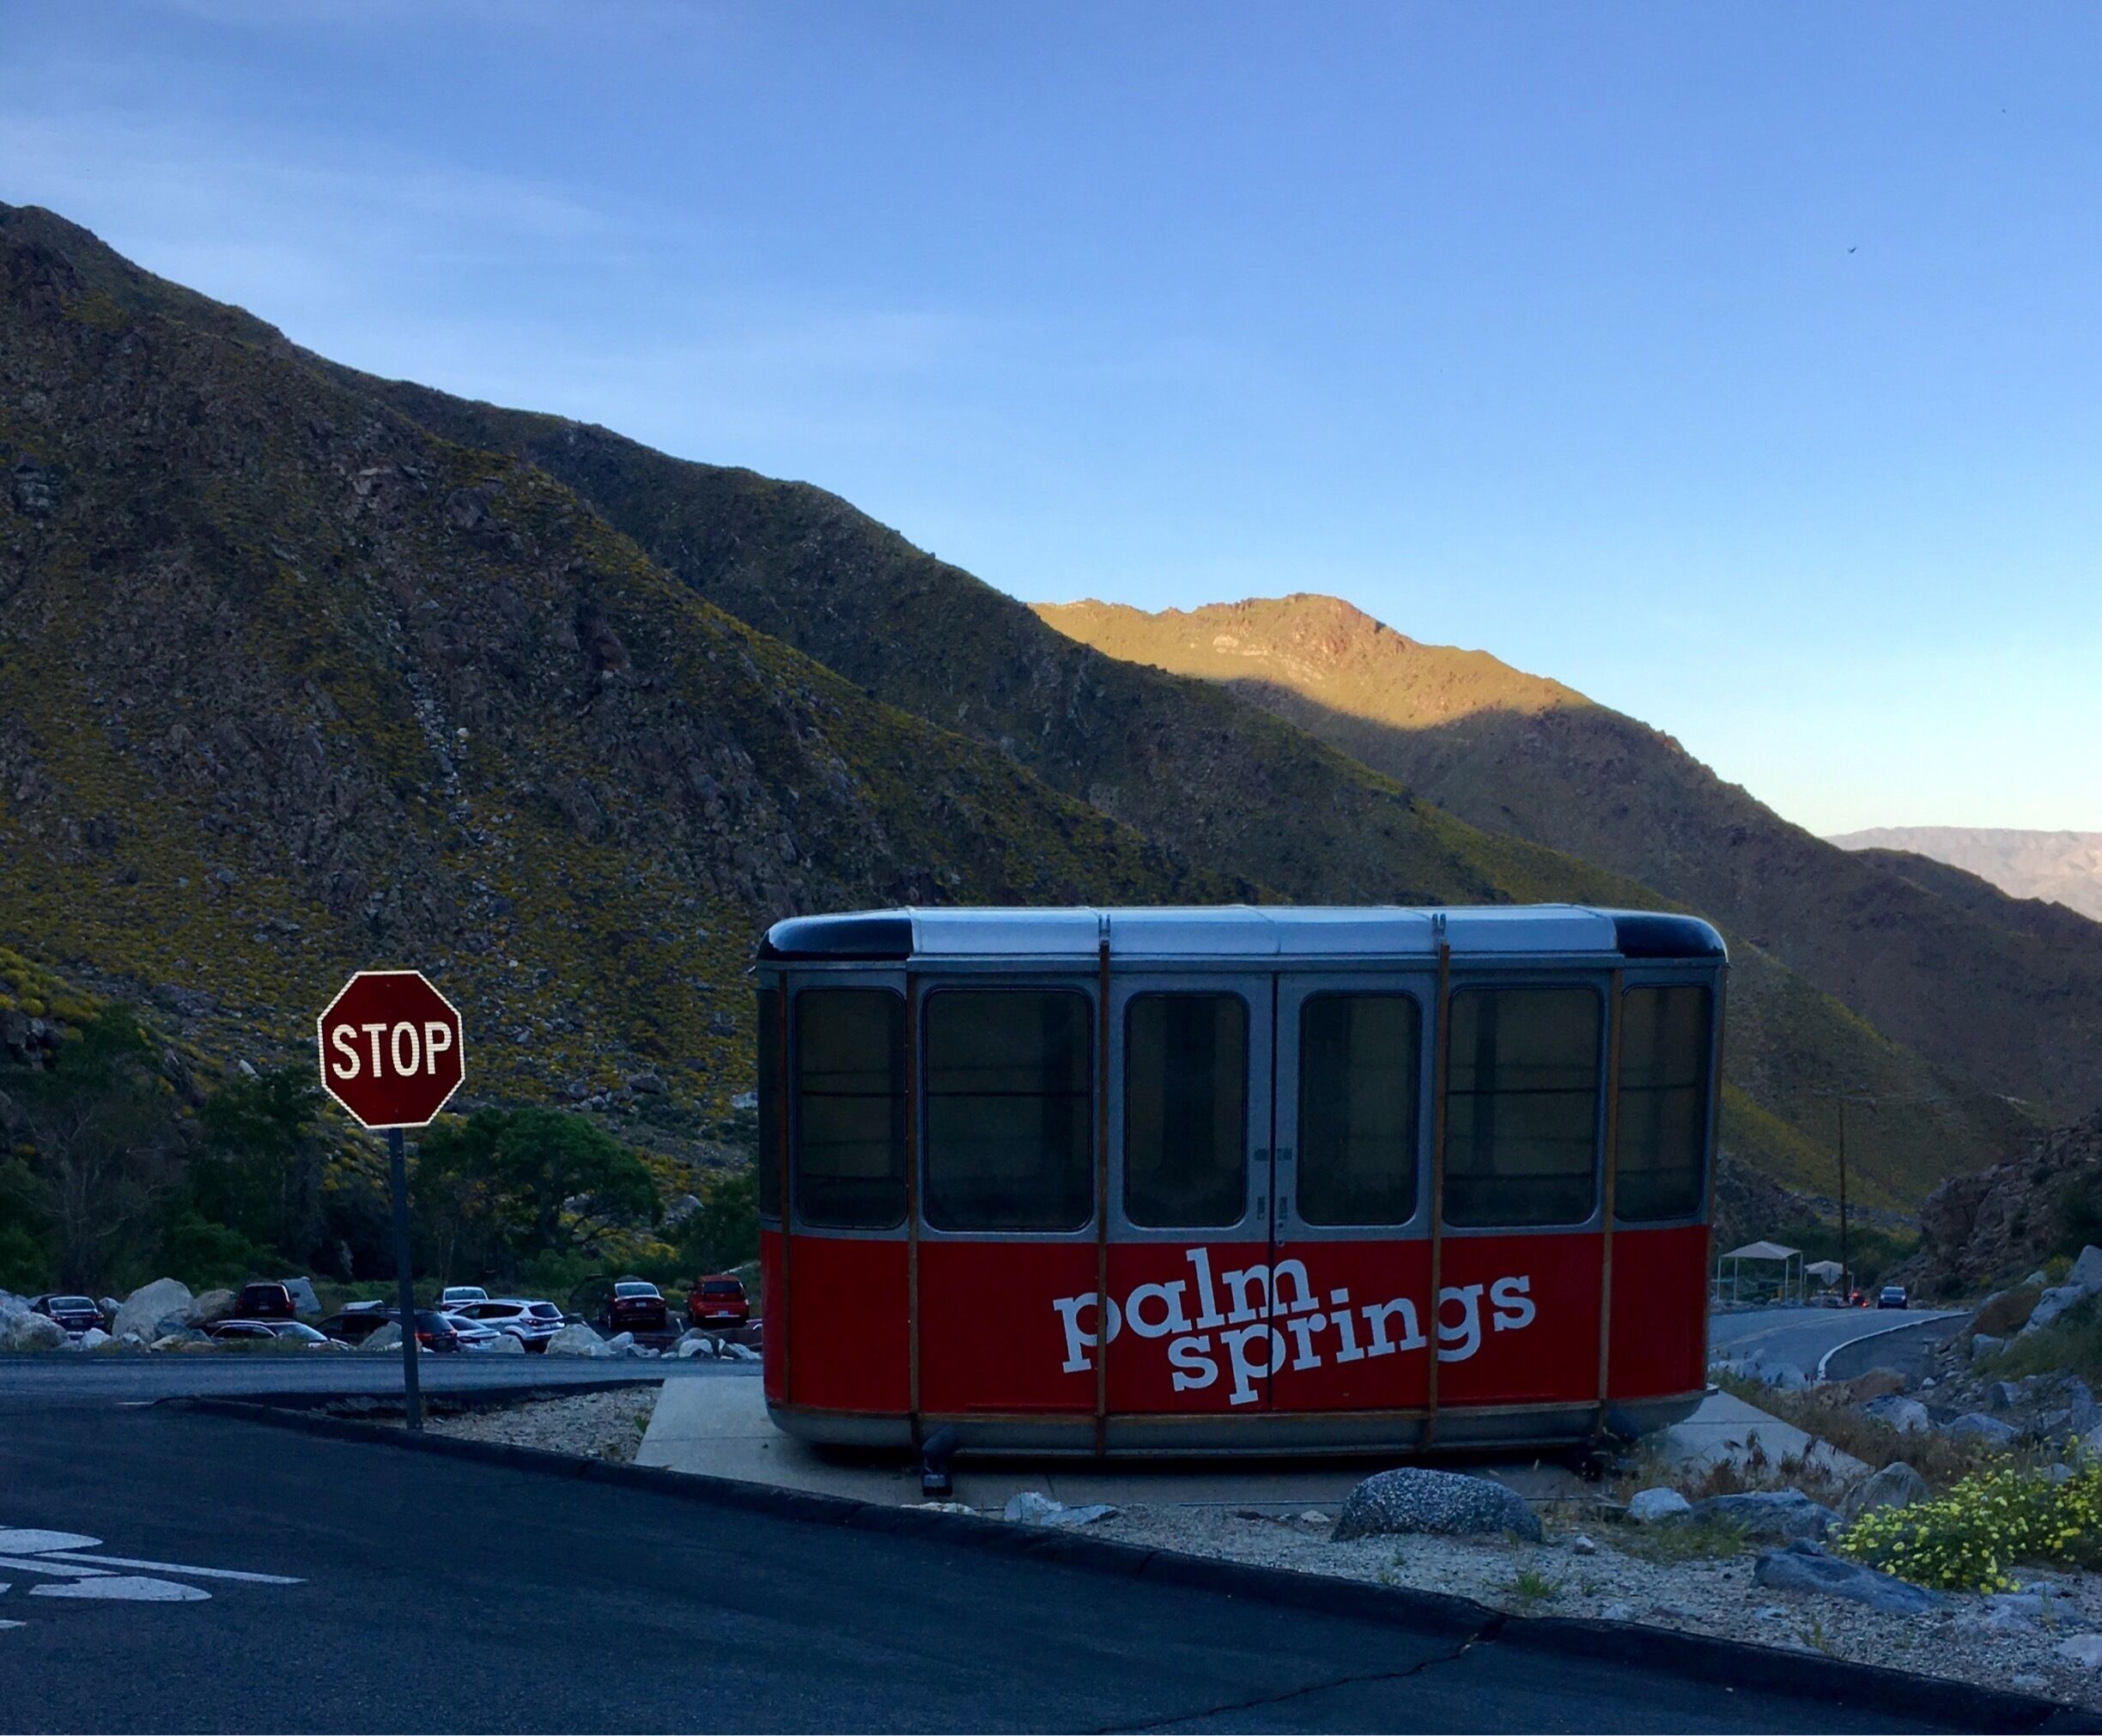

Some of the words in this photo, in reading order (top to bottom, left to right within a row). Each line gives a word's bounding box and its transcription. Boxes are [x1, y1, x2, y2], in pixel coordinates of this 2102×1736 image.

[332, 1022, 452, 1079] STOP
[1054, 1247, 1319, 1373] palm
[1168, 1276, 1536, 1405] springs
